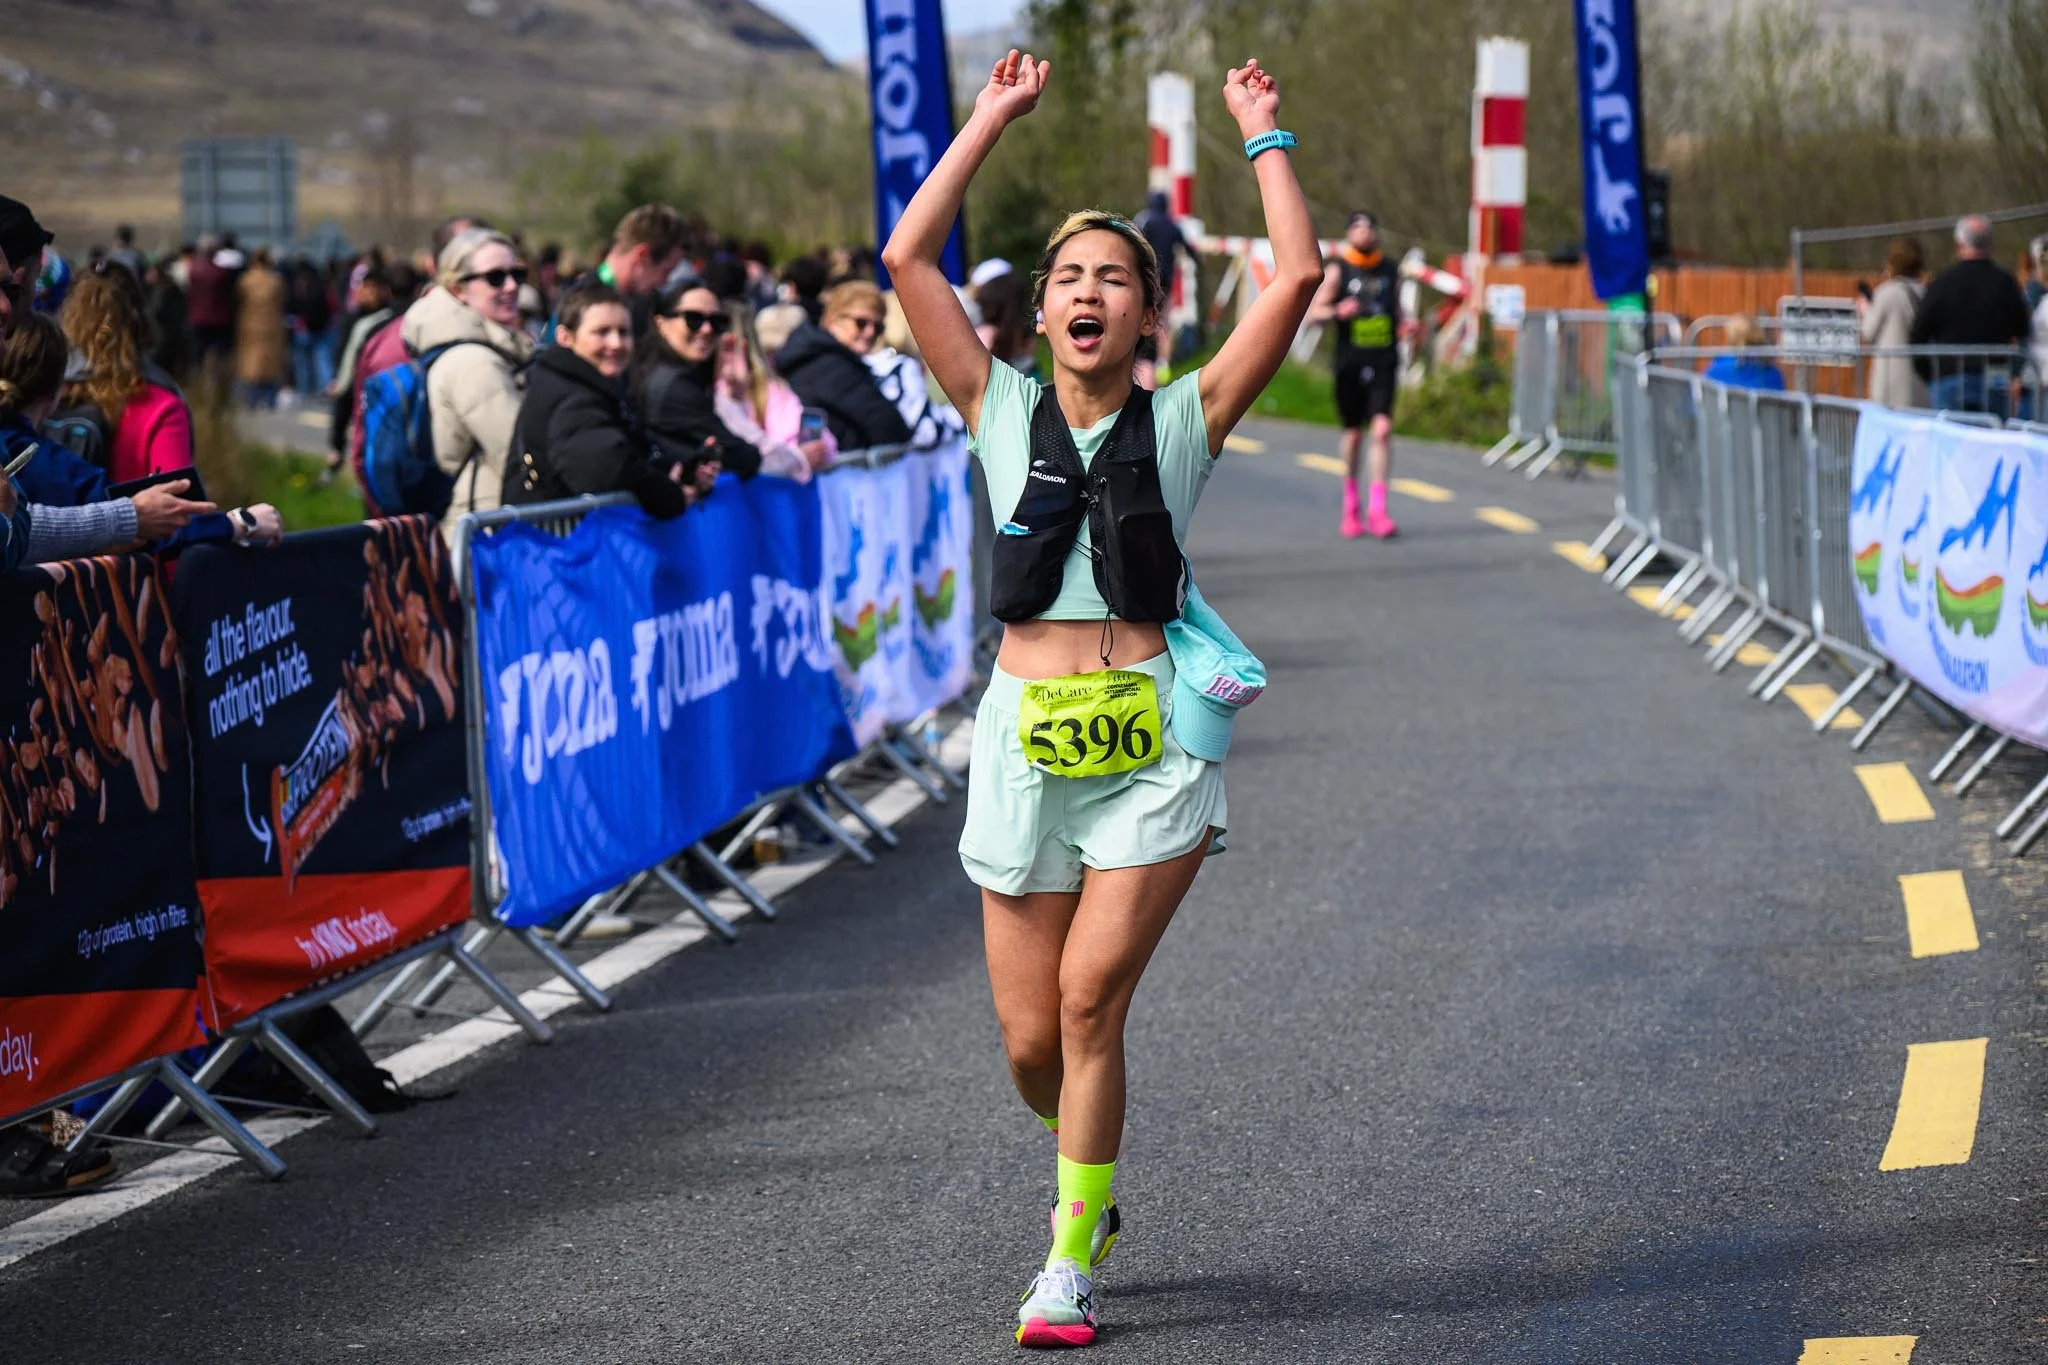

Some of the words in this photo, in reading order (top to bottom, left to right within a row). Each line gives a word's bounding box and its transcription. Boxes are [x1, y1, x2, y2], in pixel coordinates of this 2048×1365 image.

[1029, 470, 1067, 484] SALOMON
[204, 619, 222, 677] all
[221, 614, 246, 667] the
[246, 597, 295, 654] flavour.
[209, 671, 264, 740] nothing
[261, 660, 278, 708] to
[276, 640, 313, 699] hide.
[1041, 685, 1093, 702] DeCare
[1030, 709, 1153, 768] 5396
[102, 916, 136, 953] protein.
[134, 910, 160, 941] high
[0, 1026, 40, 1082] day.
